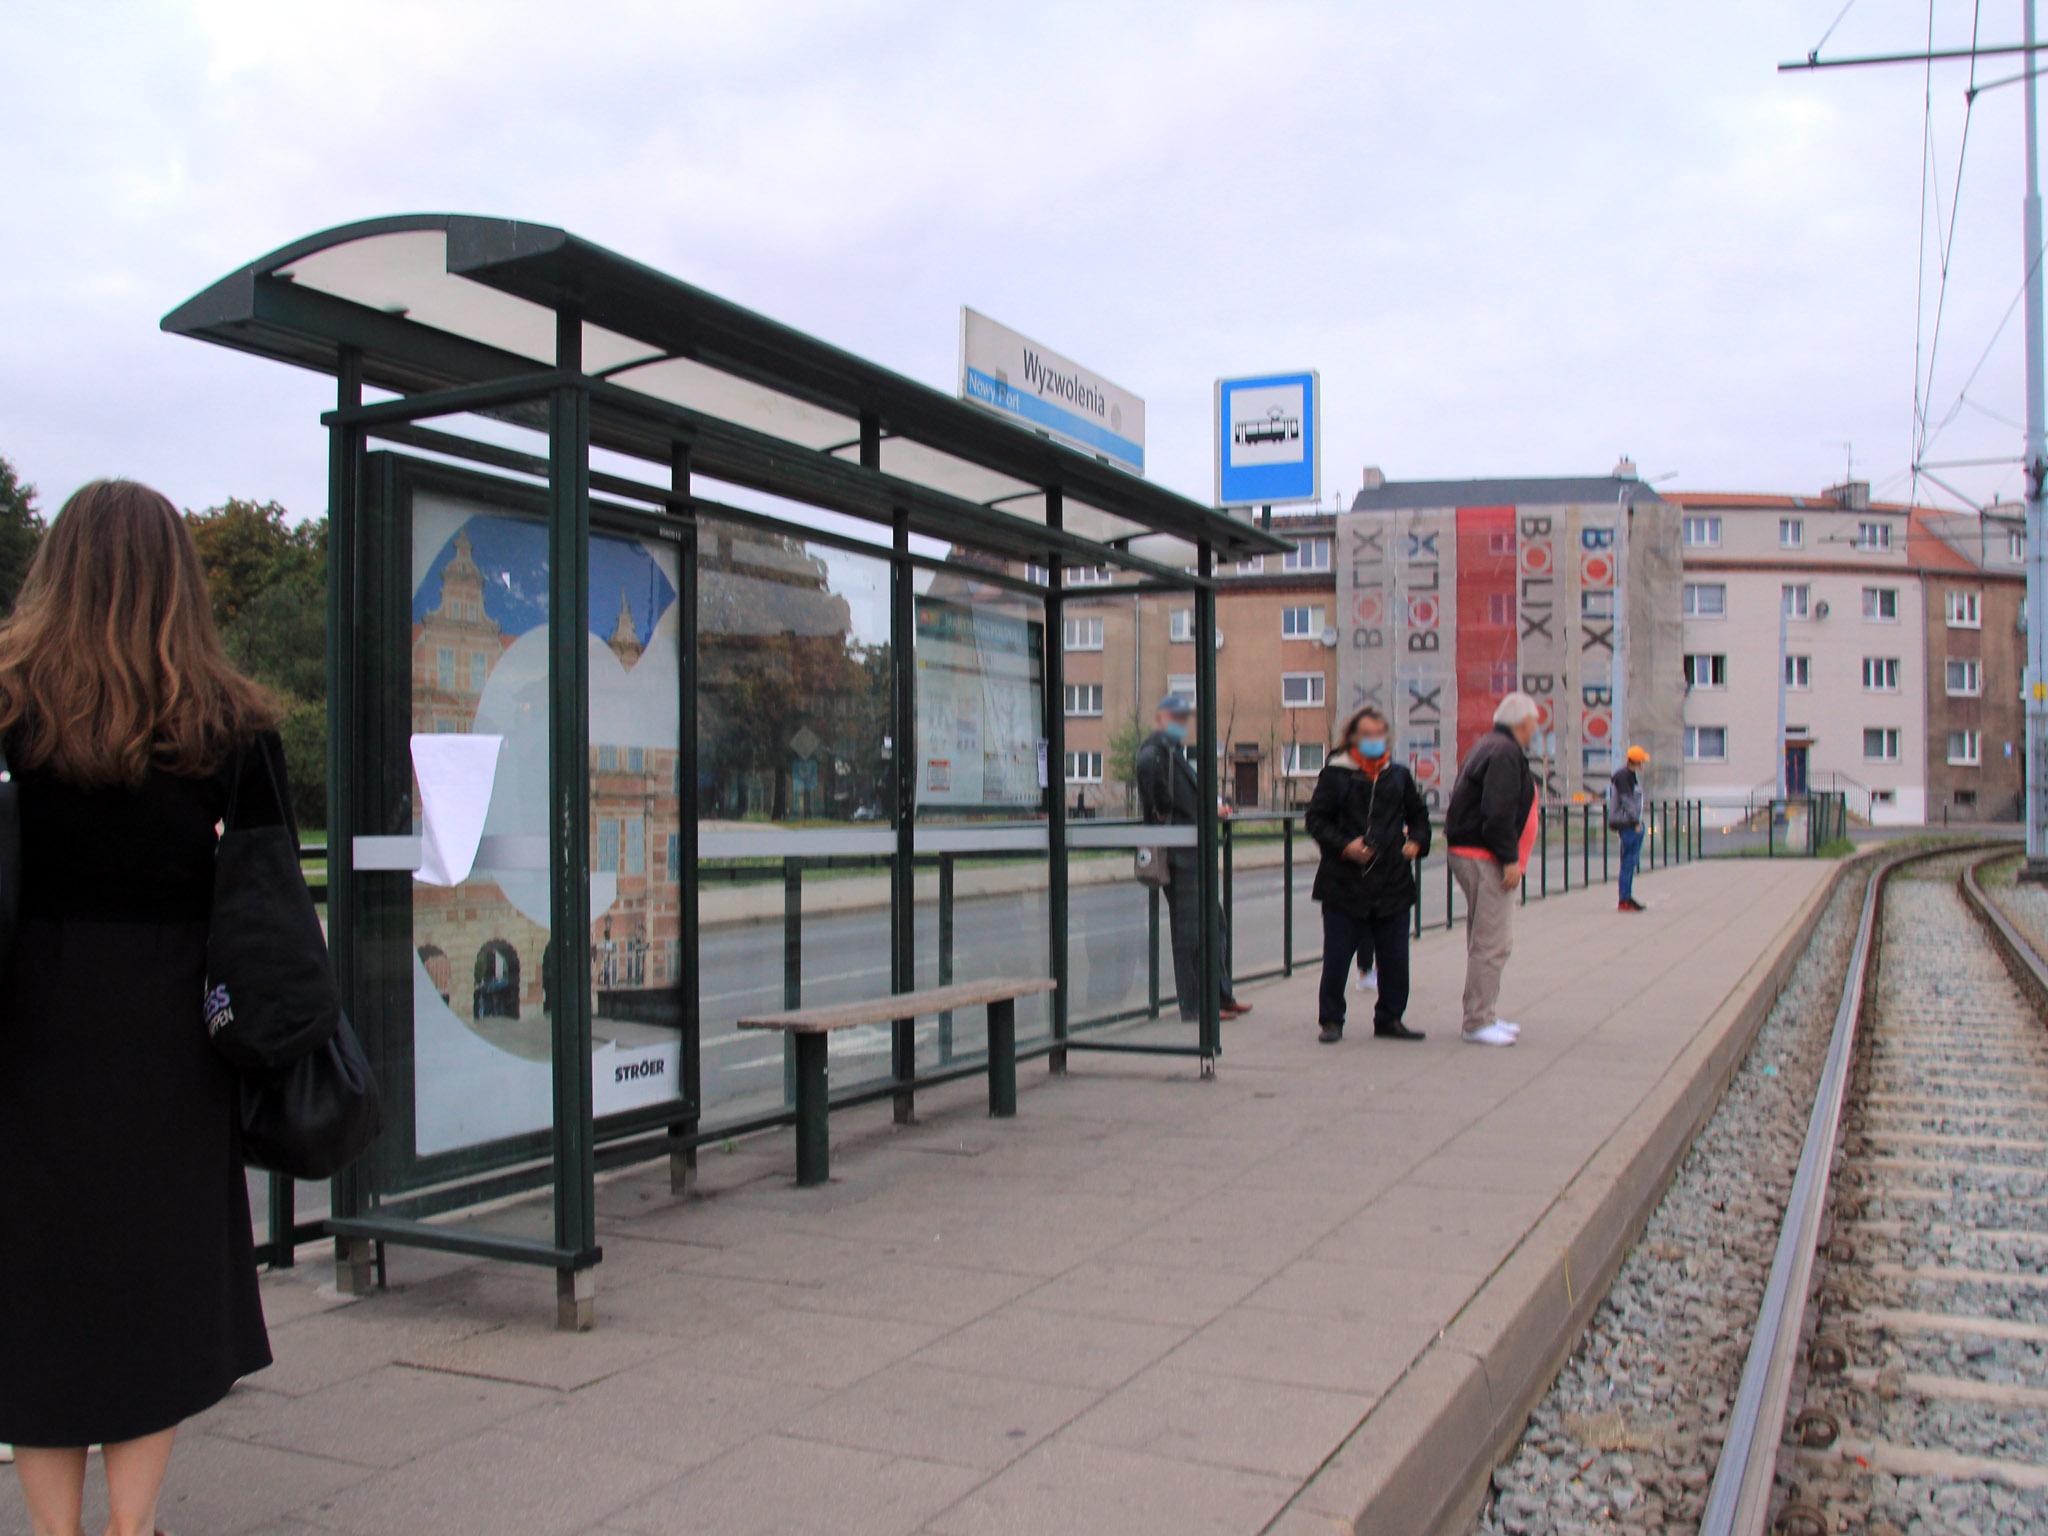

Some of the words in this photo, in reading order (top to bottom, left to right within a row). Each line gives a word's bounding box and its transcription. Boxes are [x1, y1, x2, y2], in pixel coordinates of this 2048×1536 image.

[968, 371, 997, 405] Nowy
[998, 384, 1021, 412] Port
[1023, 348, 1105, 417] Wyzwolenia
[1408, 530, 1440, 653] BOLIX
[1521, 518, 1553, 640] BOLIX
[1581, 528, 1614, 650] BOLIX
[615, 1059, 664, 1082] STRÖER
